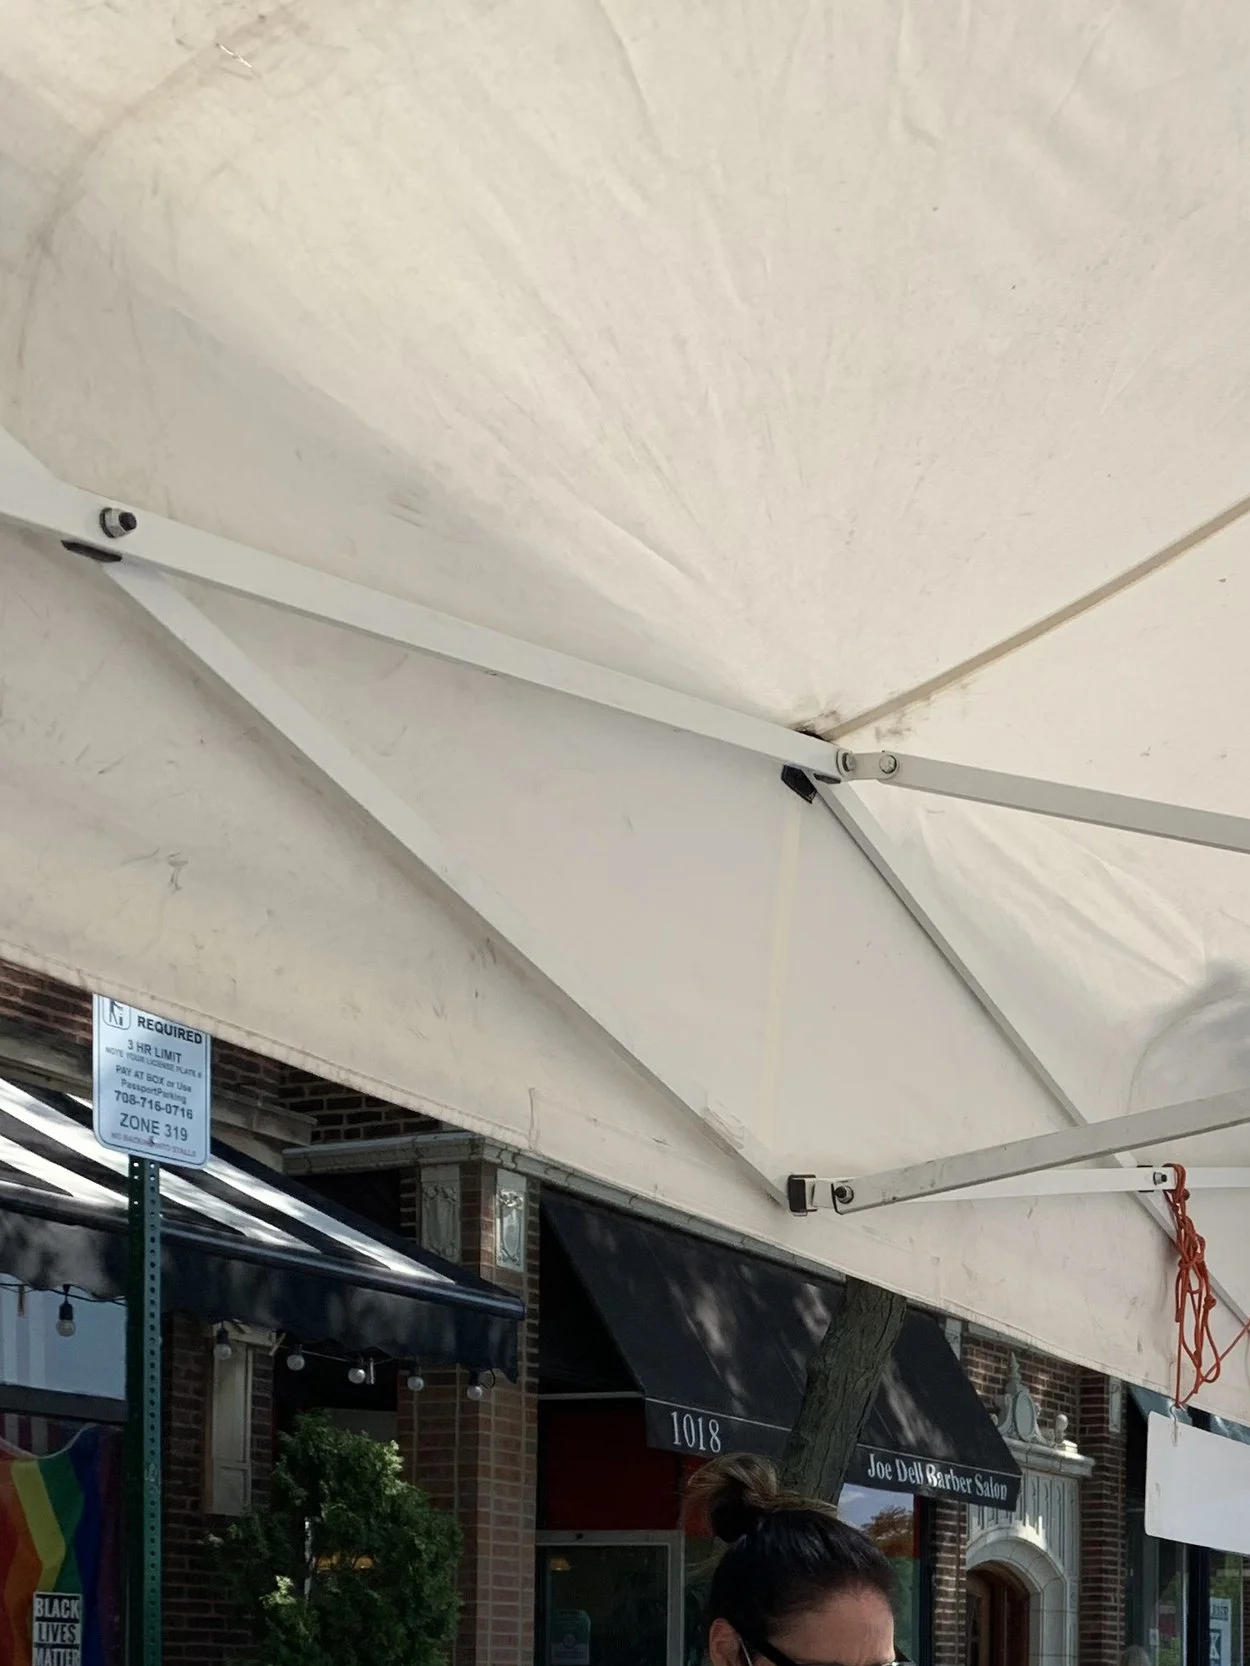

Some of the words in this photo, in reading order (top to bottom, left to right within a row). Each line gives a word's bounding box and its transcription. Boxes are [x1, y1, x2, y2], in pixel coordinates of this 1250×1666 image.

[137, 1015, 203, 1045] REQUIRED
[127, 1039, 134, 1051] 3
[136, 1042, 152, 1056] HR
[155, 1045, 182, 1064] LIMIT
[115, 1064, 132, 1079] PAY
[134, 1069, 146, 1081] AT
[147, 1072, 165, 1087] BOX
[177, 1081, 192, 1093] Use
[120, 1112, 160, 1136] ZONE
[165, 1123, 189, 1142] 319
[670, 1410, 722, 1453] 1018
[867, 1453, 893, 1481] Joe
[896, 1458, 923, 1486] Dell
[926, 1463, 973, 1496] Barber
[975, 1474, 1008, 1501] Salon
[34, 1598, 80, 1619] BLACK
[38, 1622, 77, 1643] LIVES
